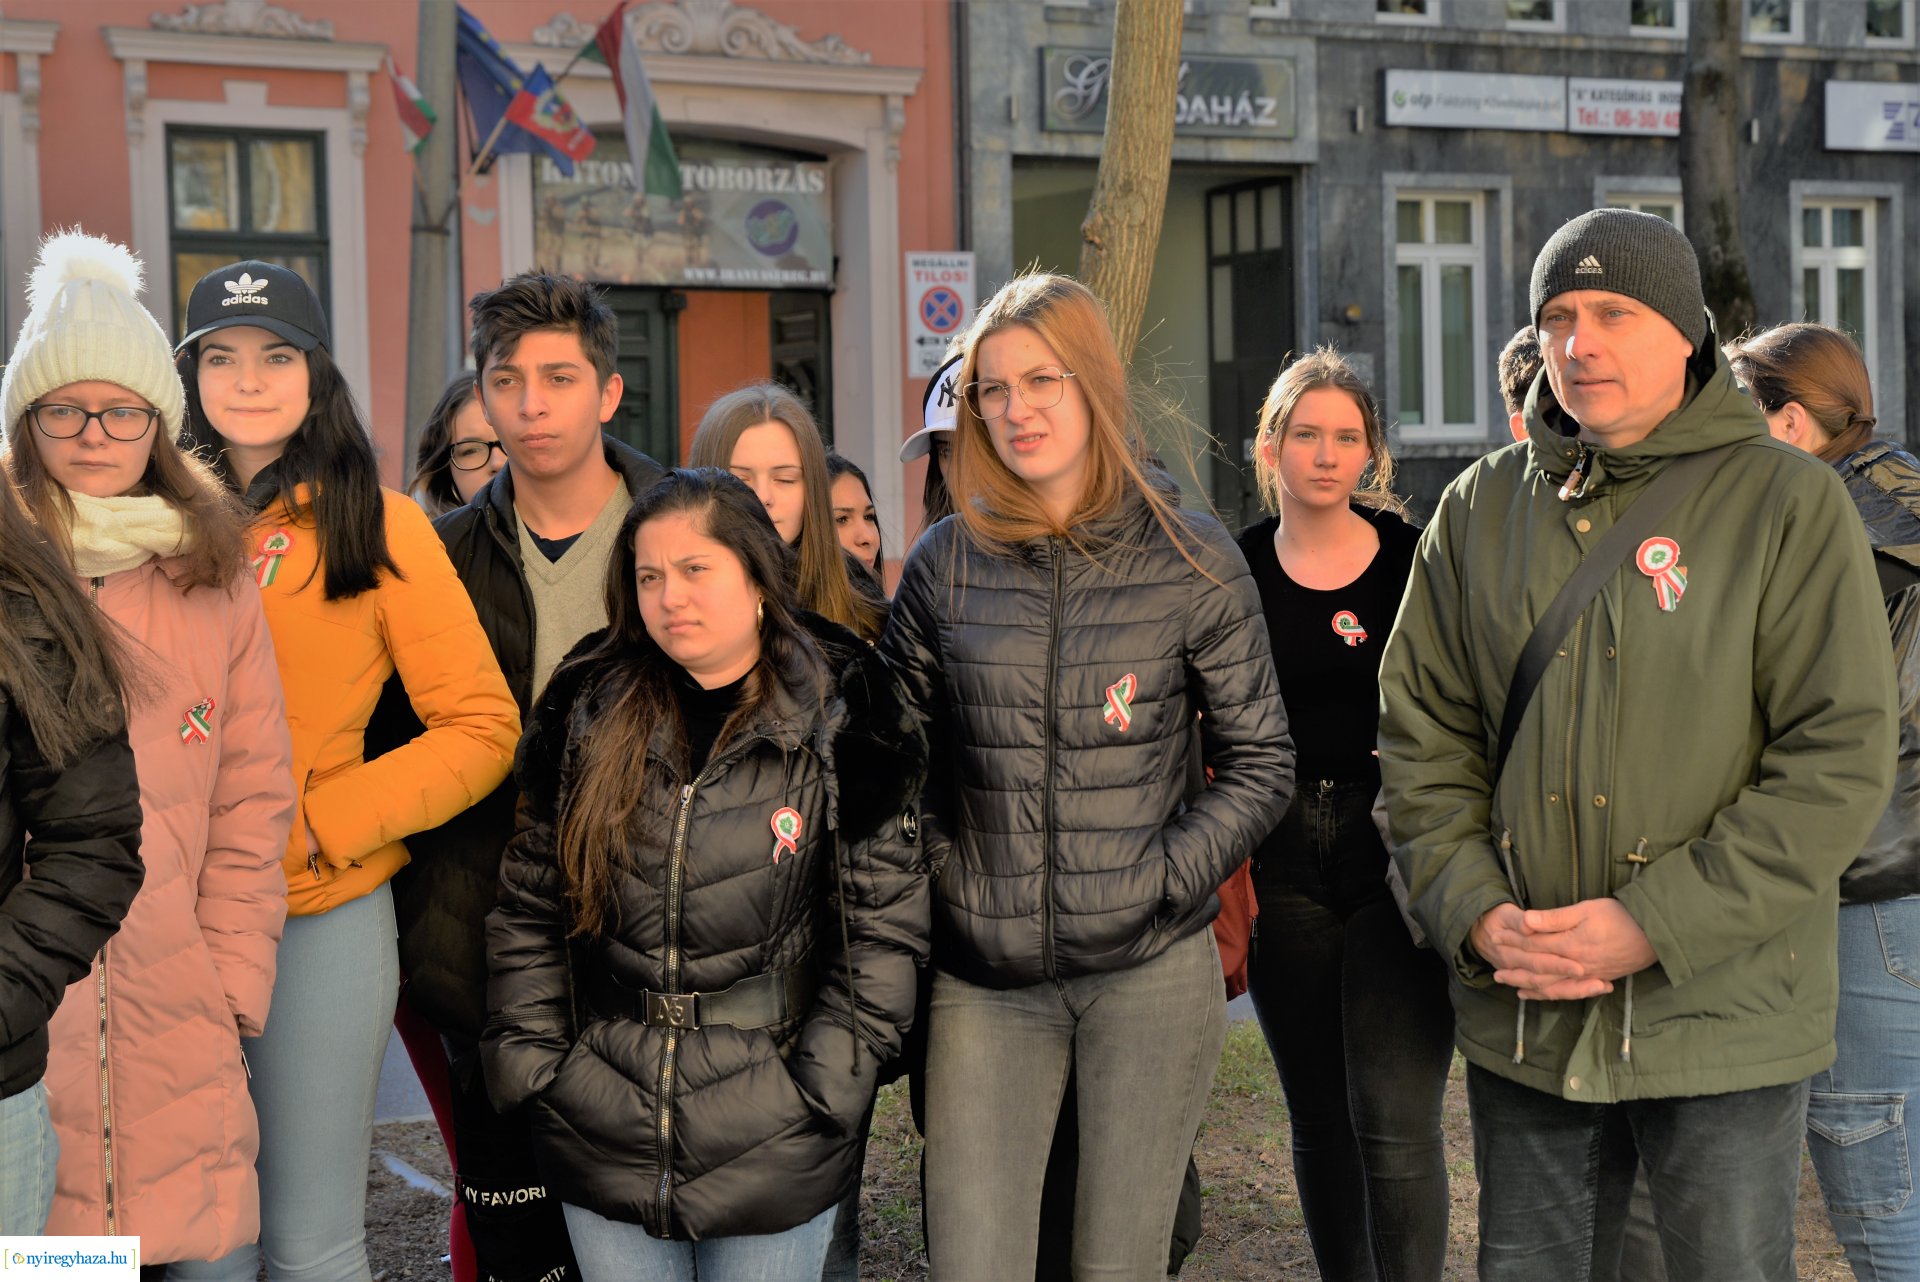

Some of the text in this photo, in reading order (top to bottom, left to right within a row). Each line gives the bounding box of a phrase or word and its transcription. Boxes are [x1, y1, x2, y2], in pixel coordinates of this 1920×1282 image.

[1173, 90, 1278, 126] DAHÁZ
[1575, 266, 1603, 274] adidas
[221, 294, 269, 307] adidas
[481, 1186, 546, 1206] FAVORI
